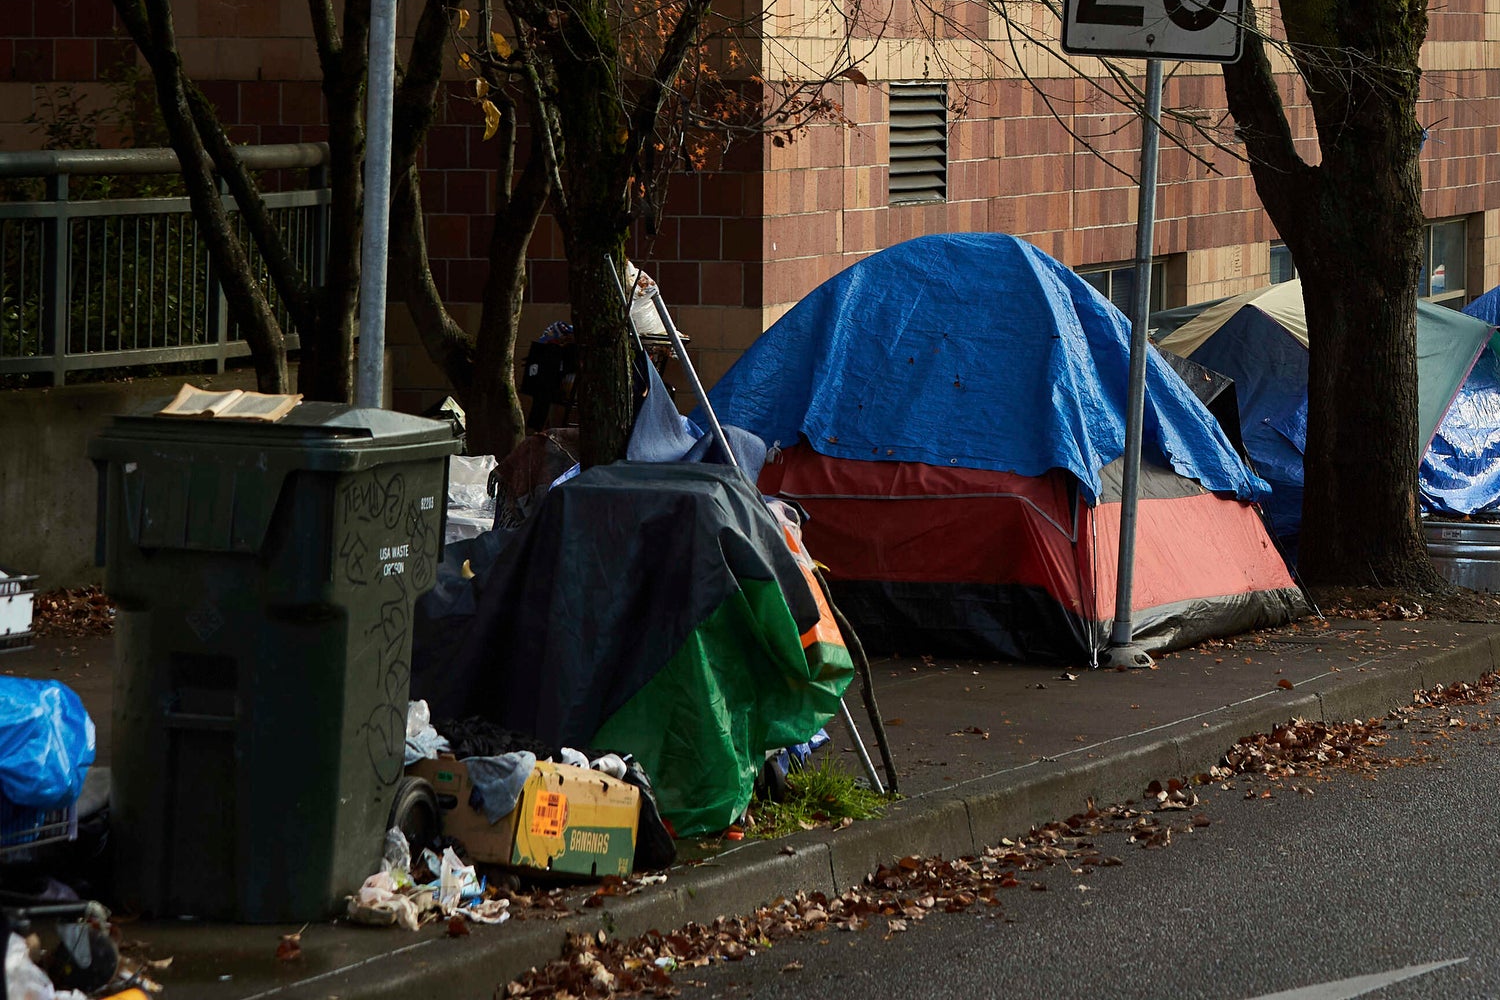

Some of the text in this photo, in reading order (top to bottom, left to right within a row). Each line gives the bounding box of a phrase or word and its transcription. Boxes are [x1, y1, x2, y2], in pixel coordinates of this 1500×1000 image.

[380, 544, 409, 560] USA WASTE
[570, 829, 610, 855] BANANAS
